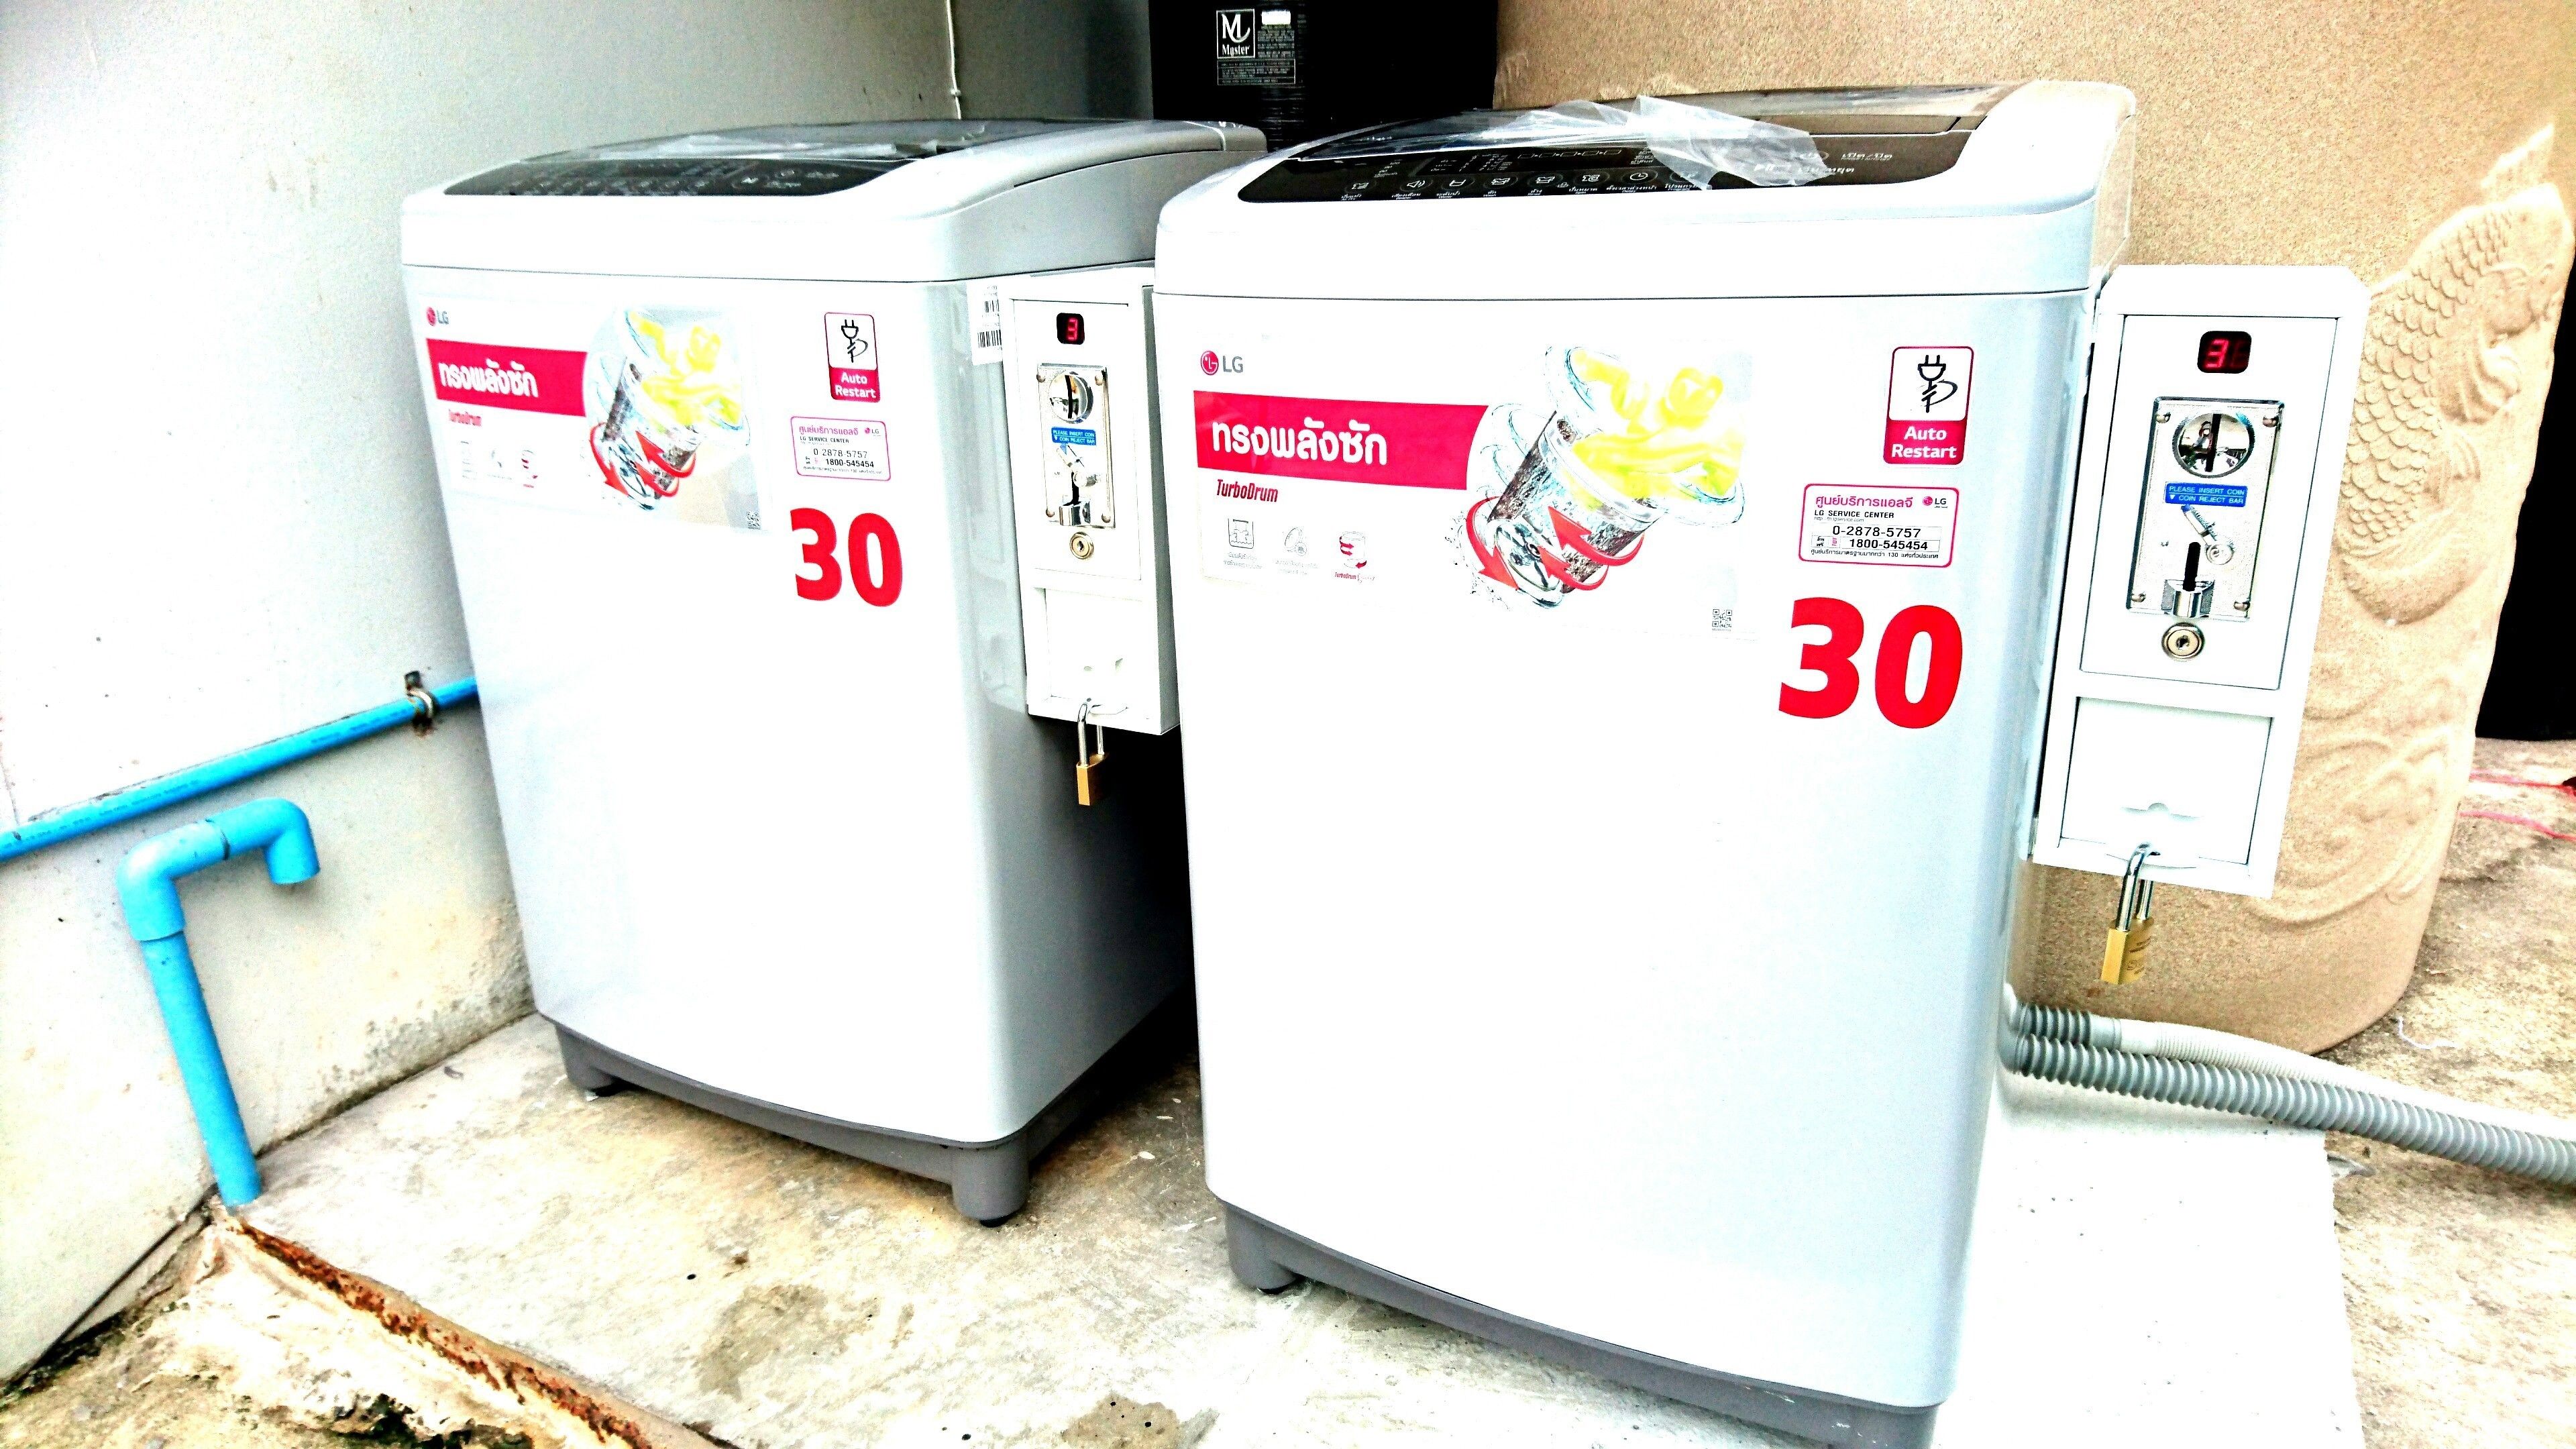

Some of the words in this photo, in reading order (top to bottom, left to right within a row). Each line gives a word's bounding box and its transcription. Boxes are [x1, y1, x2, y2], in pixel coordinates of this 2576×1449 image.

[1222, 44, 1250, 56] Master
[436, 309, 449, 325] LG
[1067, 317, 1079, 341] 3
[1222, 355, 1244, 374] LG
[438, 358, 539, 398] ทรงพลังซัก
[841, 370, 868, 384] Auto
[835, 385, 877, 399] Restart
[1212, 417, 1388, 466] ทรงพลังซัก
[1904, 427, 1947, 441] Auto
[1891, 444, 1957, 459] Restart
[826, 458, 874, 468] 1800-545454
[1216, 479, 1279, 502] TurboDrum
[1815, 494, 1913, 508] ศูนย์บริการแอลจี
[1832, 525, 1921, 538] 0-2878-5757
[1849, 539, 1928, 551] 1800-545454
[790, 508, 903, 606] 30
[1779, 597, 1962, 729] 30
